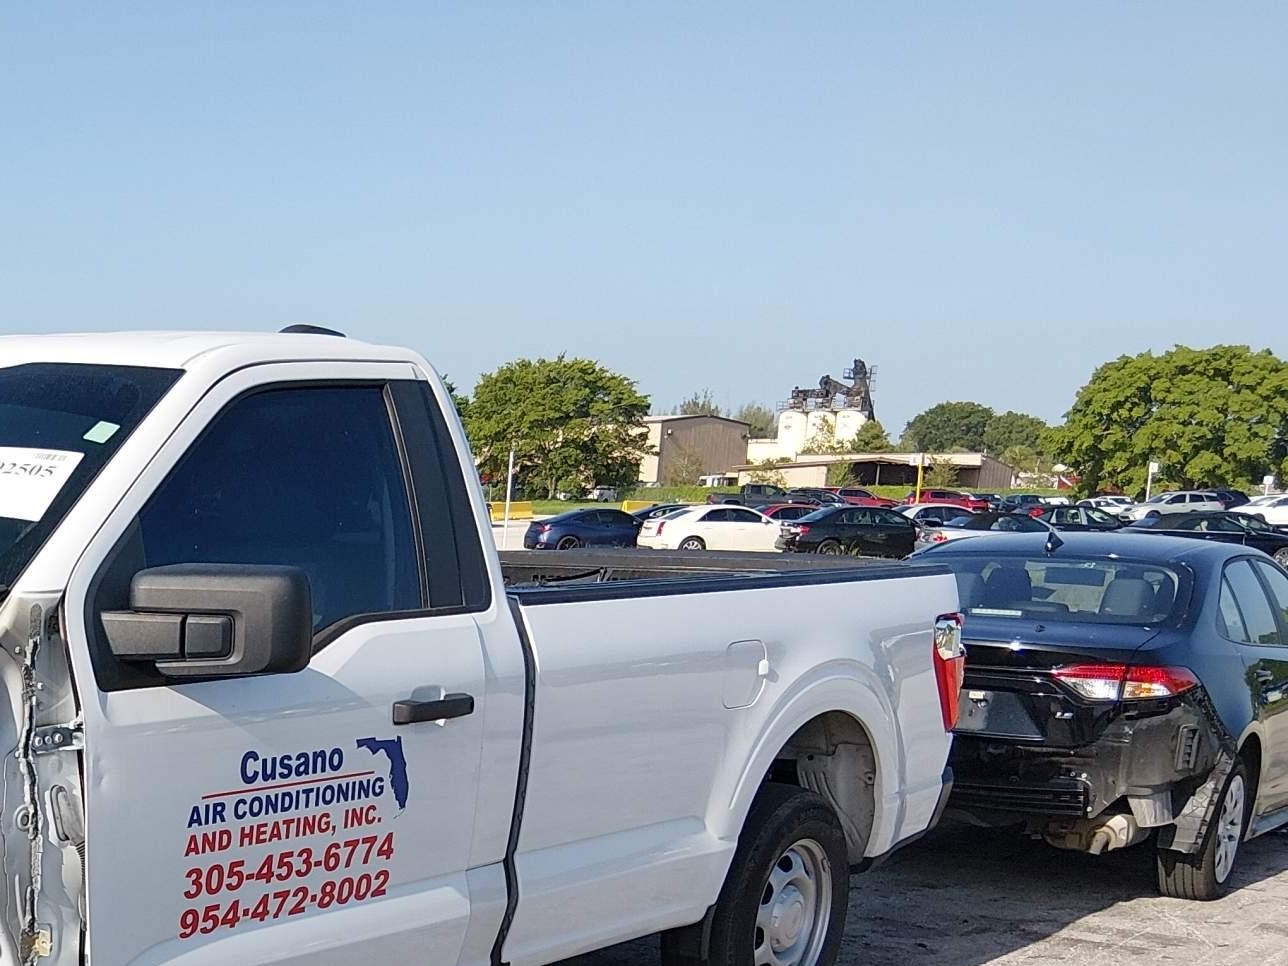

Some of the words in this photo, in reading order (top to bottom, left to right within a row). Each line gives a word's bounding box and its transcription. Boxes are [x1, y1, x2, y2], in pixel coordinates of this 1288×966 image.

[240, 747, 344, 785] Cusano
[187, 801, 226, 828] AIR
[233, 776, 385, 820] CONDITIONING
[184, 829, 232, 857] AND
[239, 812, 337, 848] HEATING,
[343, 804, 383, 830] INC.
[183, 831, 395, 900] 305-453-6774
